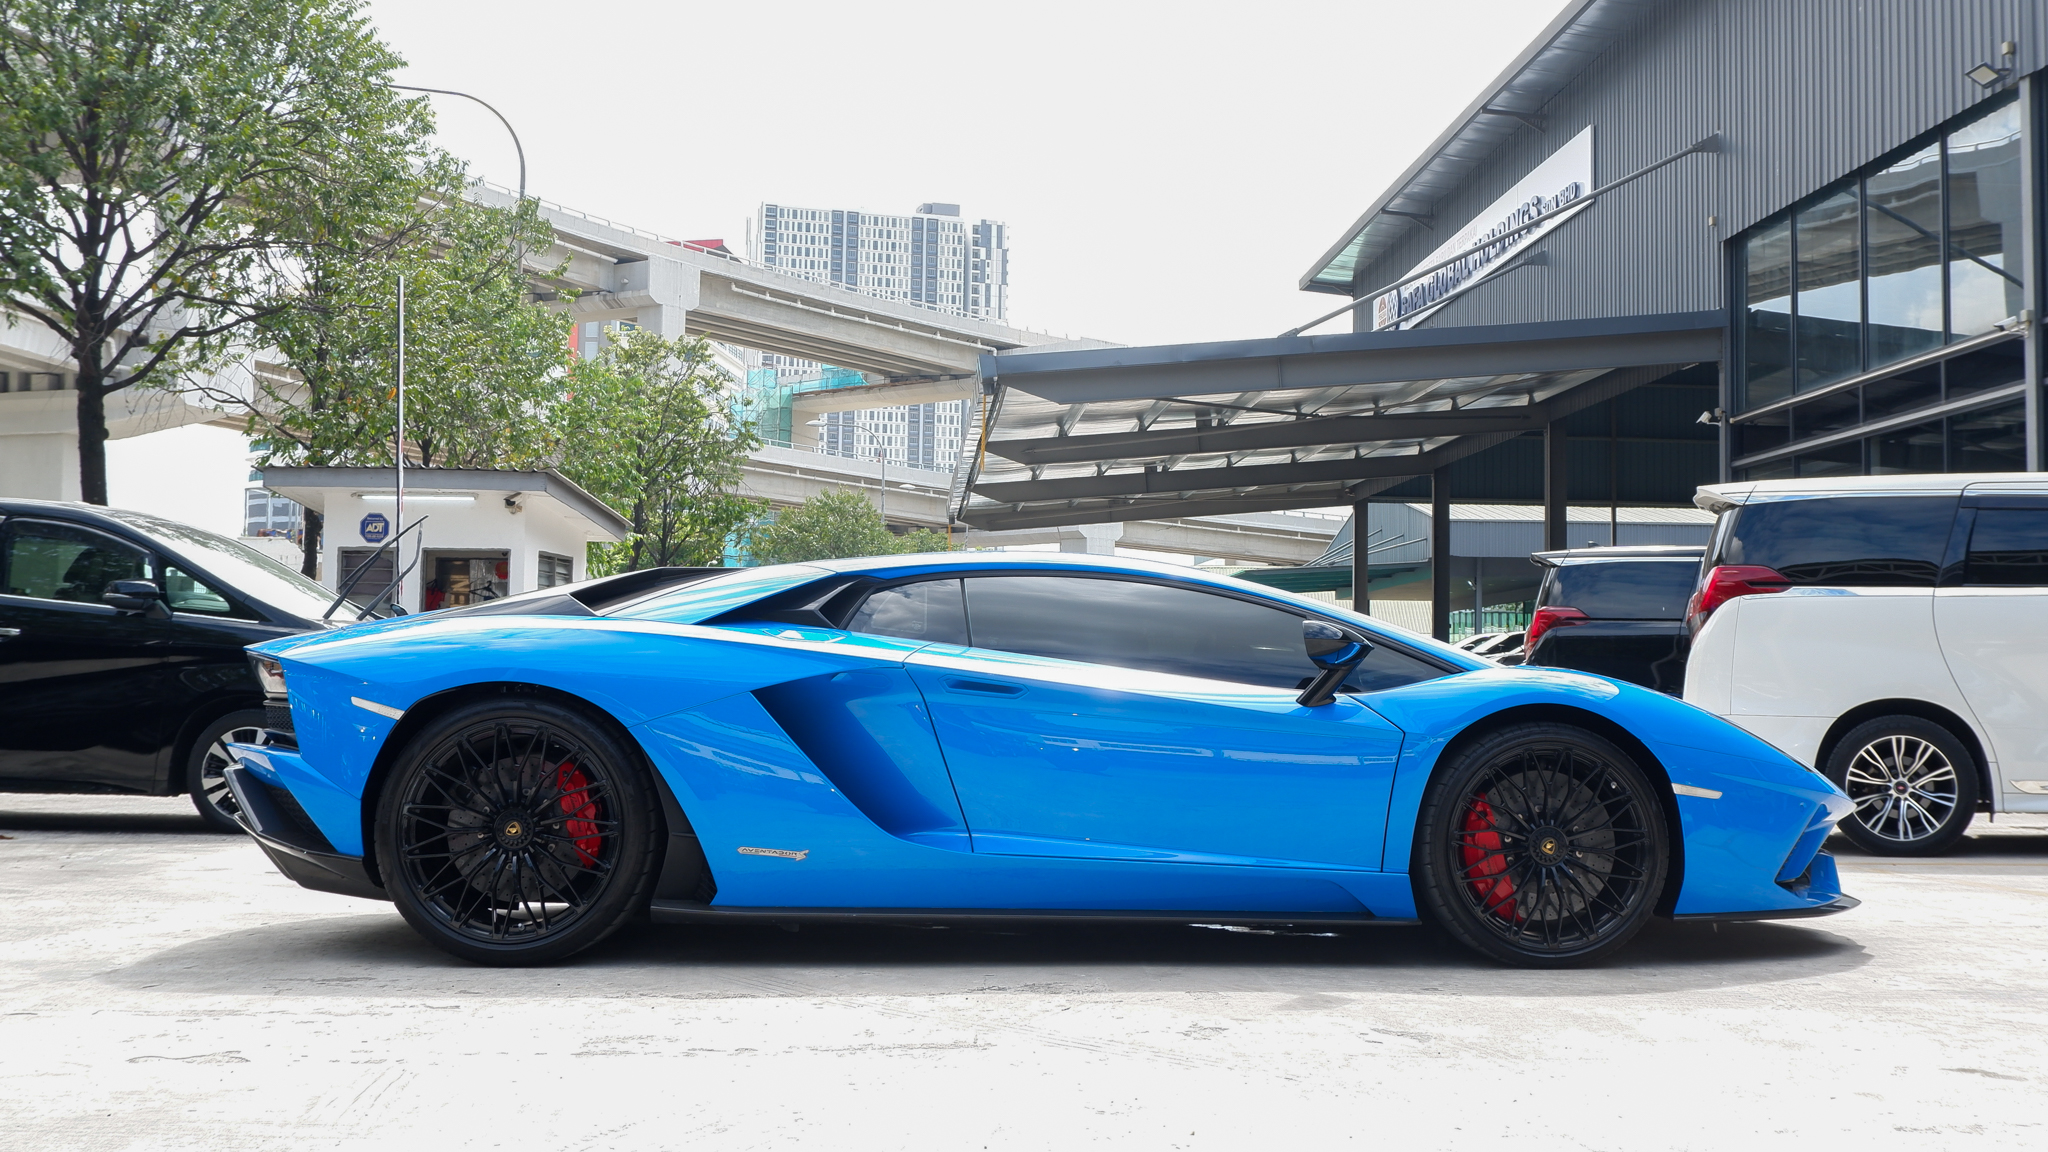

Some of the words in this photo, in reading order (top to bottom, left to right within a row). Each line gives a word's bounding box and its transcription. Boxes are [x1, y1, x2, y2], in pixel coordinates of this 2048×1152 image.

[1401, 283, 1426, 315] SAFA
[1427, 250, 1469, 302] GLOBAL
[1472, 195, 1540, 271] HOLDINGS
[1541, 194, 1557, 214] SDN
[1560, 182, 1577, 207] BHD
[365, 522, 384, 533] ADT
[741, 847, 797, 856] AVENTADOR
